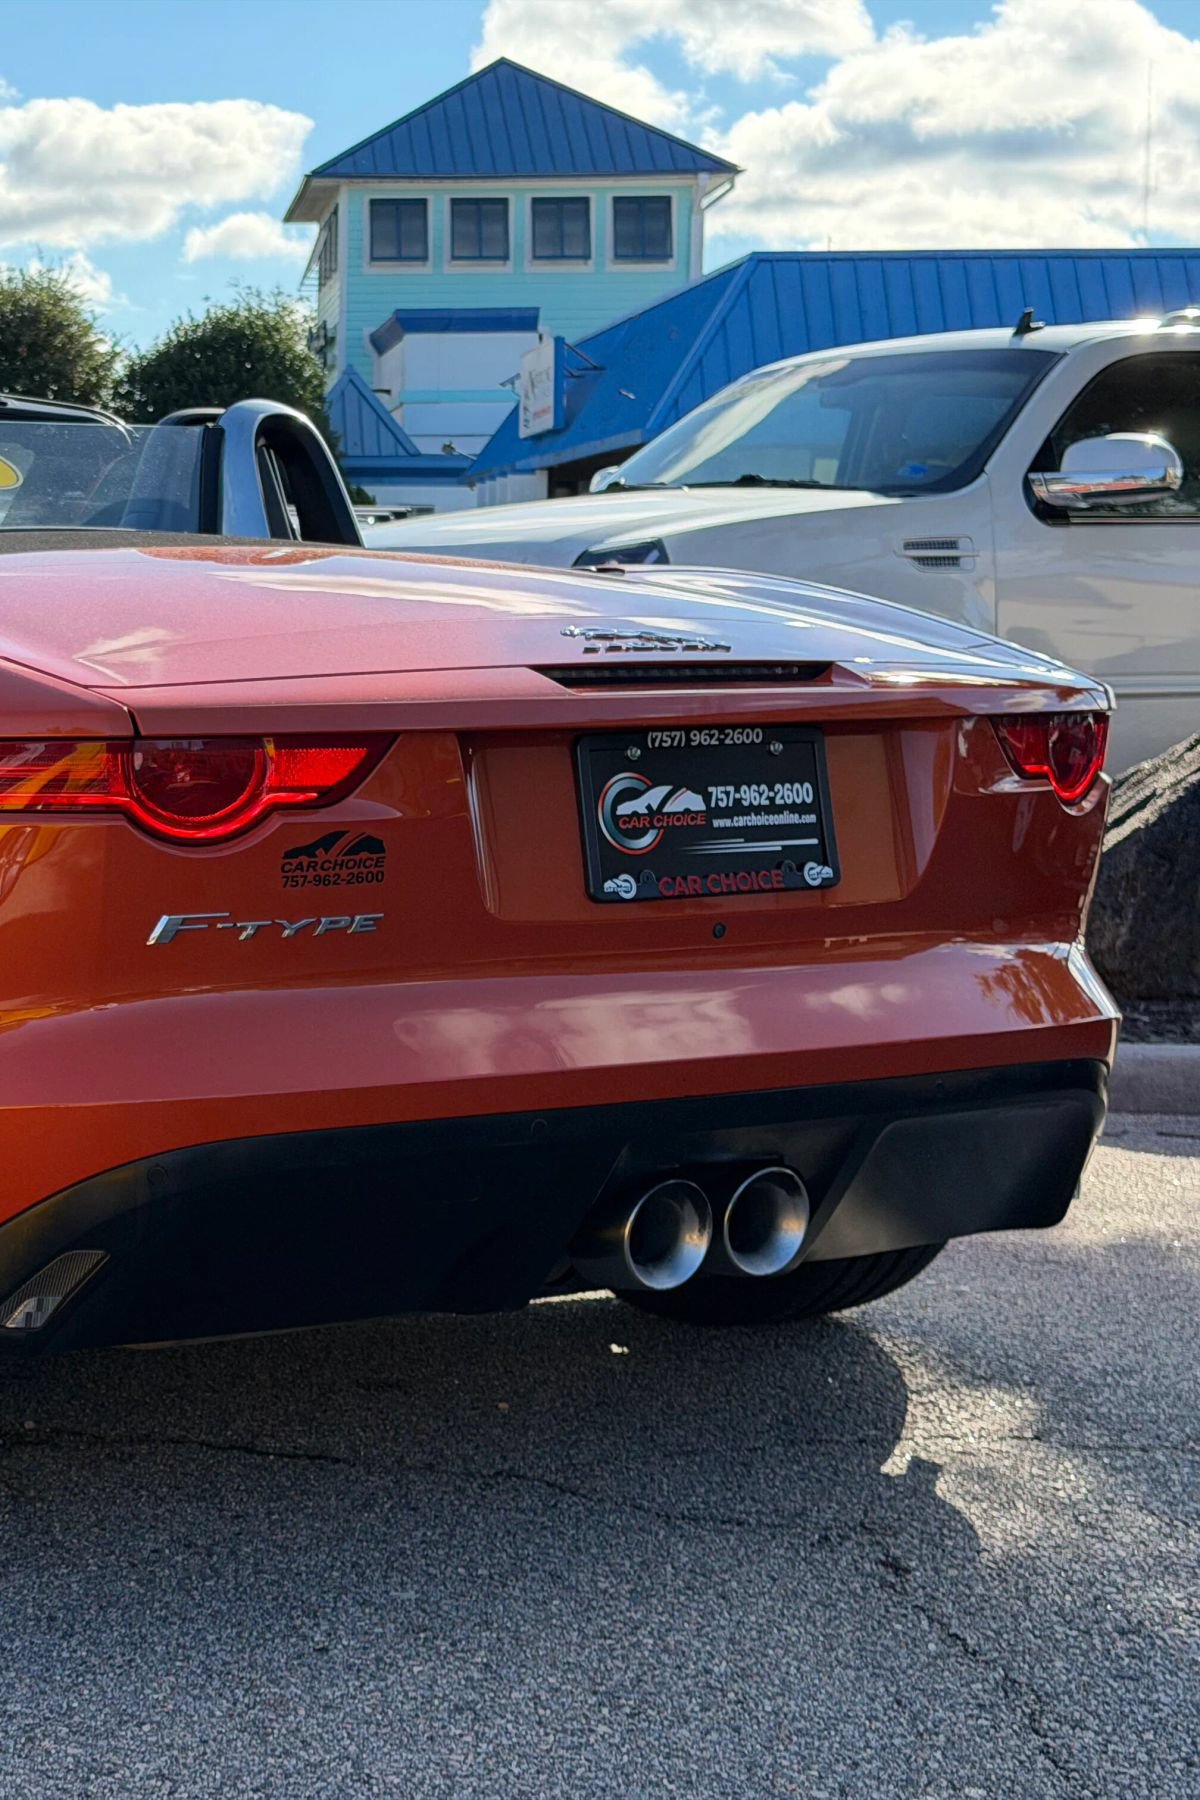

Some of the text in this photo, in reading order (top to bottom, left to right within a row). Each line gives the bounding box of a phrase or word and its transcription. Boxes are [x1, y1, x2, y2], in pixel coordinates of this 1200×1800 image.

[647, 728, 763, 749] (757) 962-2600
[707, 782, 813, 808] 757-962-2600
[618, 813, 707, 829] CAR CHOICE
[712, 810, 817, 829] www.carchoiceonline.com
[281, 855, 386, 874] CAR CHOICE
[281, 871, 385, 889] 757-962-2600
[659, 869, 785, 897] CAR CHOICE
[146, 912, 384, 945] F-TYPE
